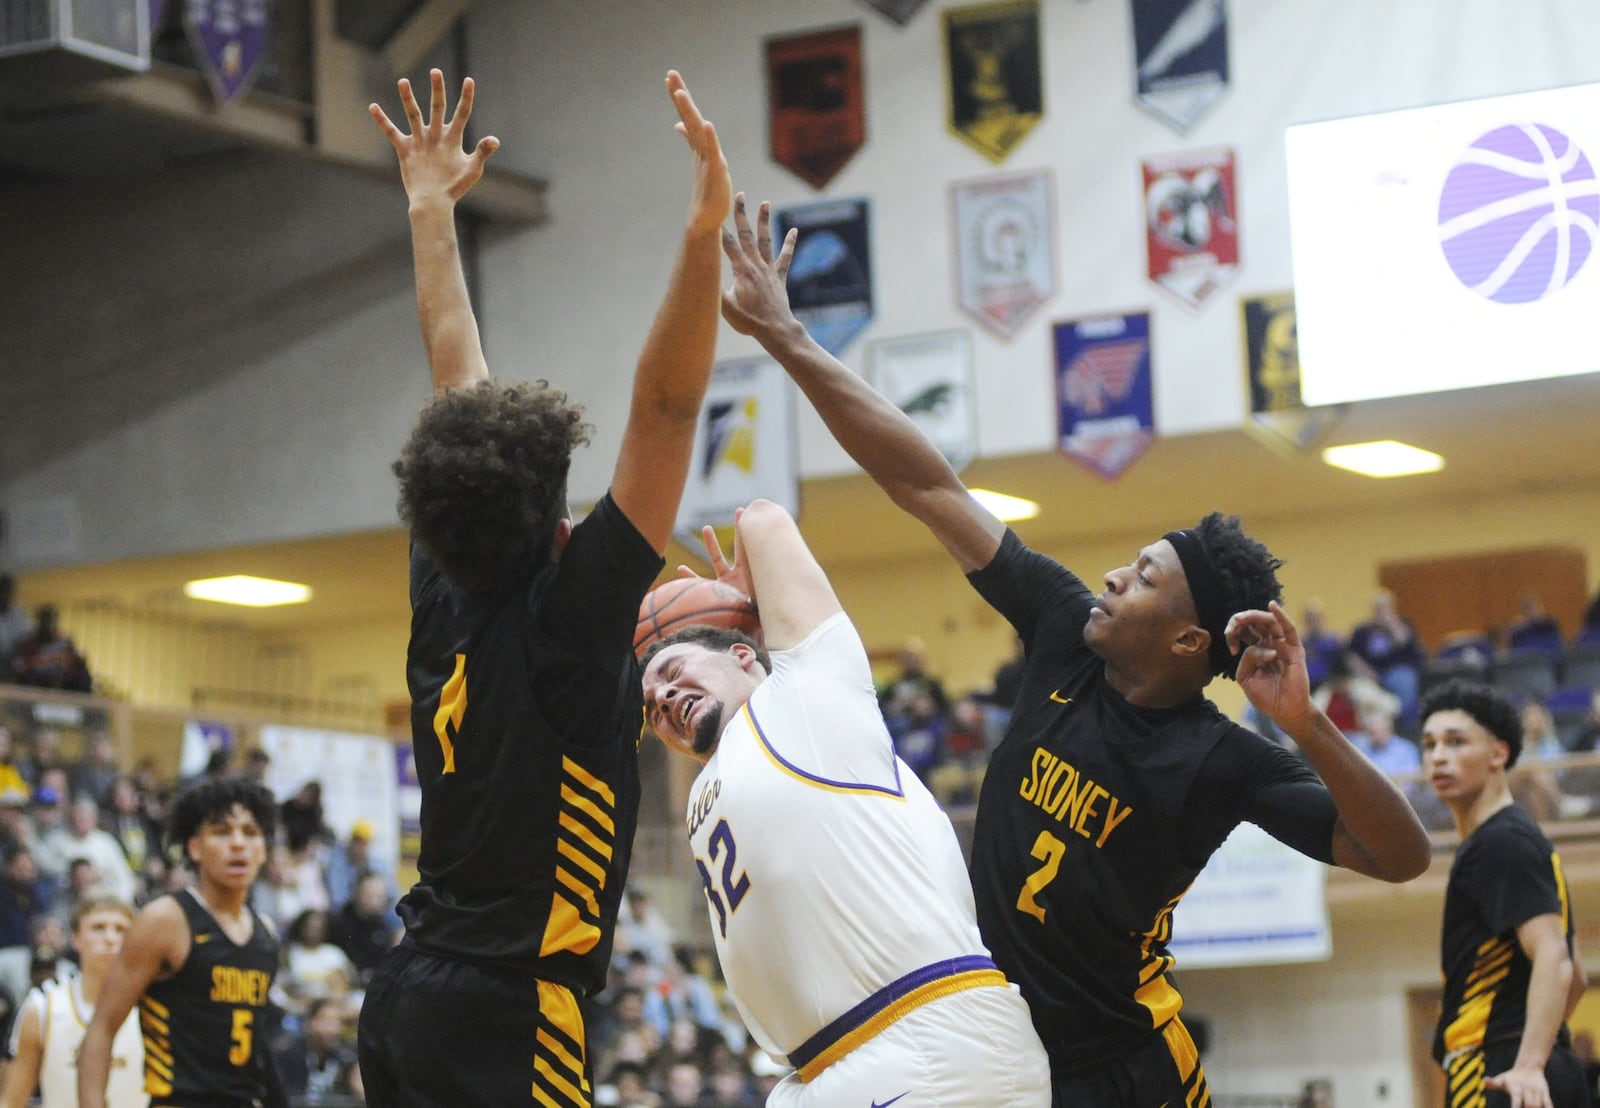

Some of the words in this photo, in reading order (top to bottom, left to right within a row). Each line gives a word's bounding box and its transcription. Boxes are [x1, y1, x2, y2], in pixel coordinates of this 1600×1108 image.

[1019, 746, 1133, 848] SIDNEY
[1016, 829, 1067, 924] 2
[210, 965, 270, 1006] SIDNEY
[229, 1008, 253, 1066] 5
